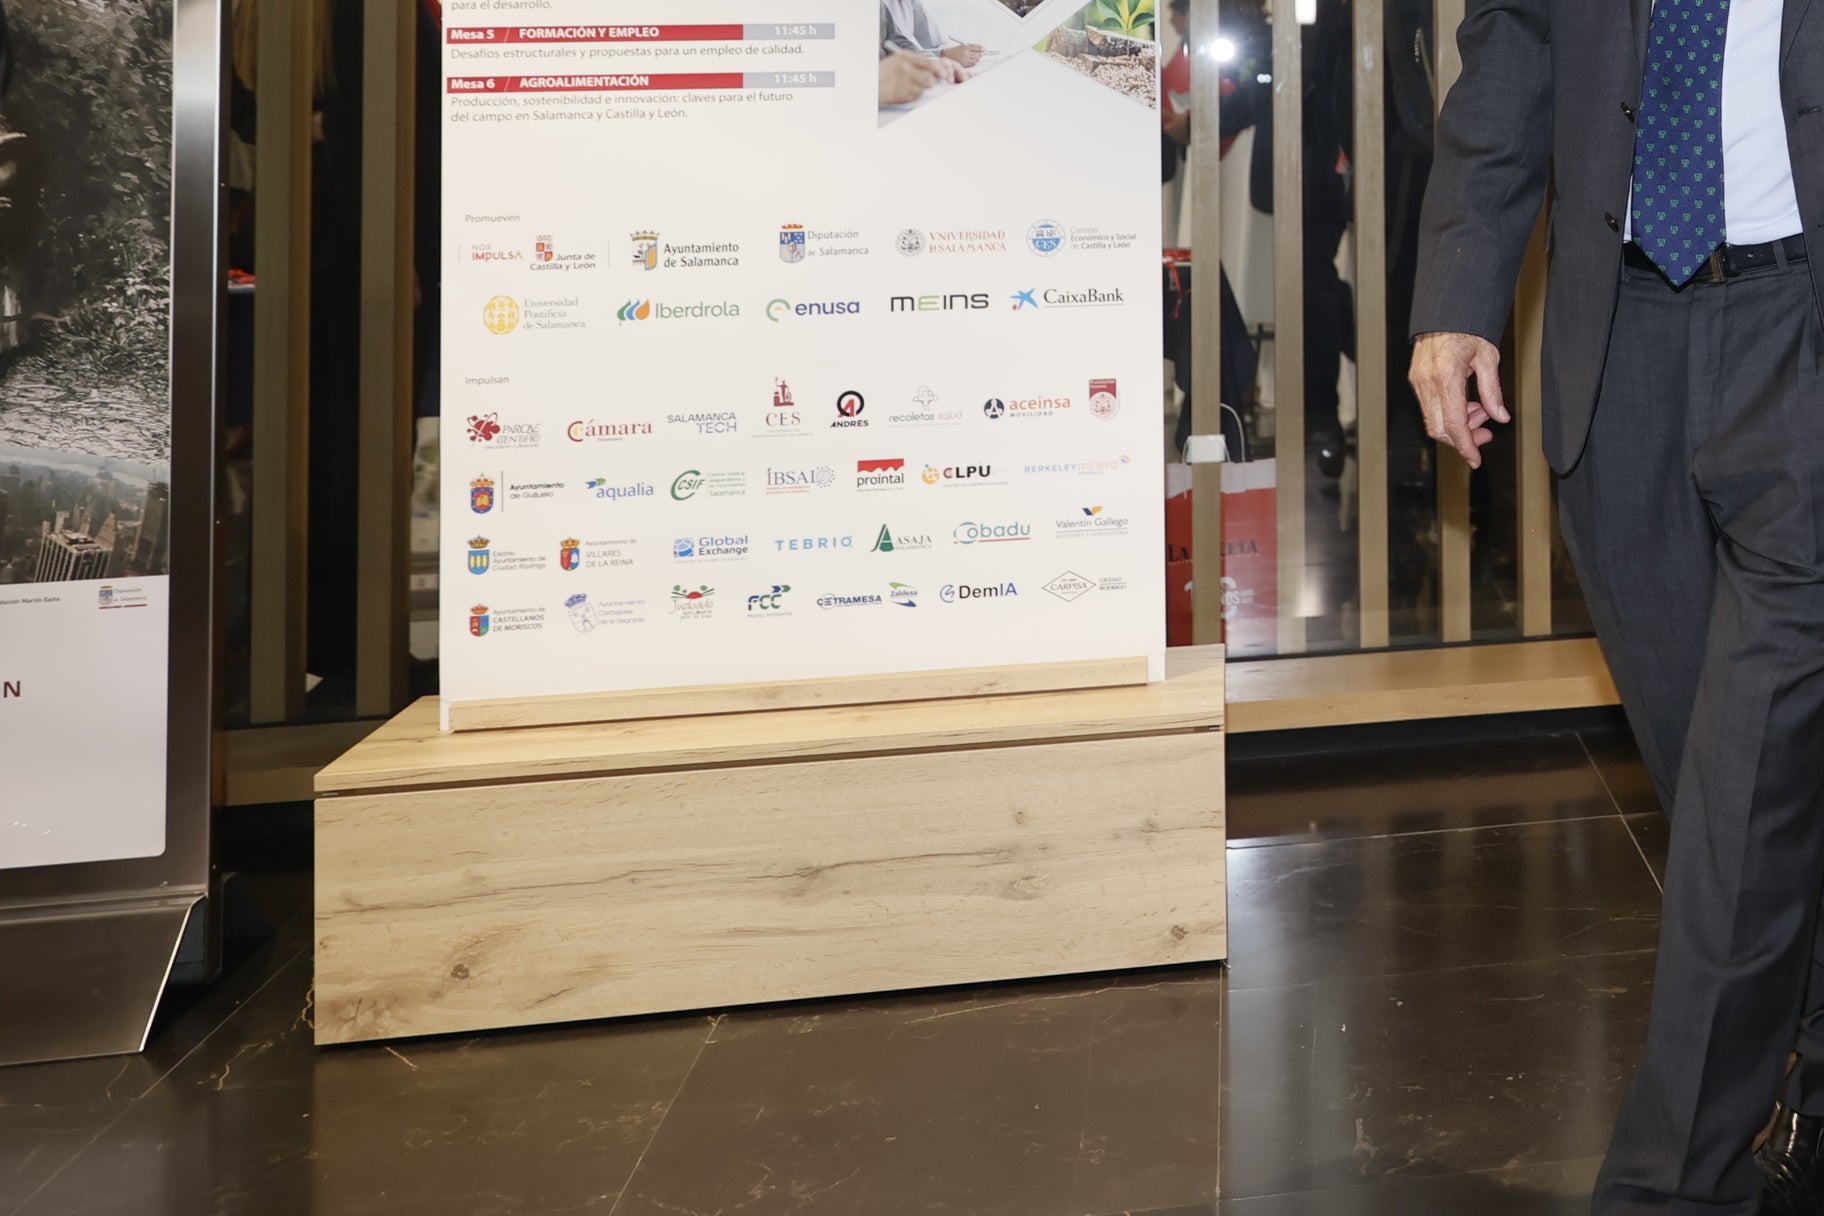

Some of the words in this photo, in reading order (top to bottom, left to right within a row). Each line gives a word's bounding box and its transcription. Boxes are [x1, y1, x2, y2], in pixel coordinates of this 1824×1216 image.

[450, 29, 484, 40] Mesa
[485, 28, 495, 39] 5
[519, 26, 596, 38] FORMACIÓN
[598, 27, 606, 38] Y
[608, 27, 660, 38] EMPLEO
[774, 25, 806, 35] 11:45
[450, 78, 484, 89] Mesa
[485, 78, 495, 88] 6
[519, 74, 649, 88] AGROALIMENTACIÓN
[773, 73, 806, 84] 11:45
[807, 230, 859, 241] Diputación
[664, 243, 739, 256] Ayuntamiento
[819, 246, 869, 256] Salamanca
[555, 252, 582, 262] Junta
[584, 252, 596, 261] de
[664, 257, 677, 268] de
[680, 256, 739, 267] Salamanca
[530, 262, 563, 271] Castilla
[1043, 288, 1124, 304] CaixaBank
[655, 301, 740, 319] Iberdrola
[795, 301, 860, 316] enusa
[1009, 395, 1071, 411] aceinsa
[667, 412, 737, 423] SALAMANCA
[765, 412, 801, 427] CES
[888, 411, 935, 423] recoletas
[1009, 410, 1054, 418] MOVILIDAD
[696, 422, 737, 434] TECH
[830, 419, 869, 428] ANDRÉS
[943, 465, 991, 479] CLPU
[1024, 464, 1077, 474] BERKELEY
[857, 472, 905, 488] prointal
[596, 482, 654, 501] aqualia
[699, 535, 748, 547] Global
[699, 546, 748, 557] Exchange
[959, 583, 1018, 600] DemIA
